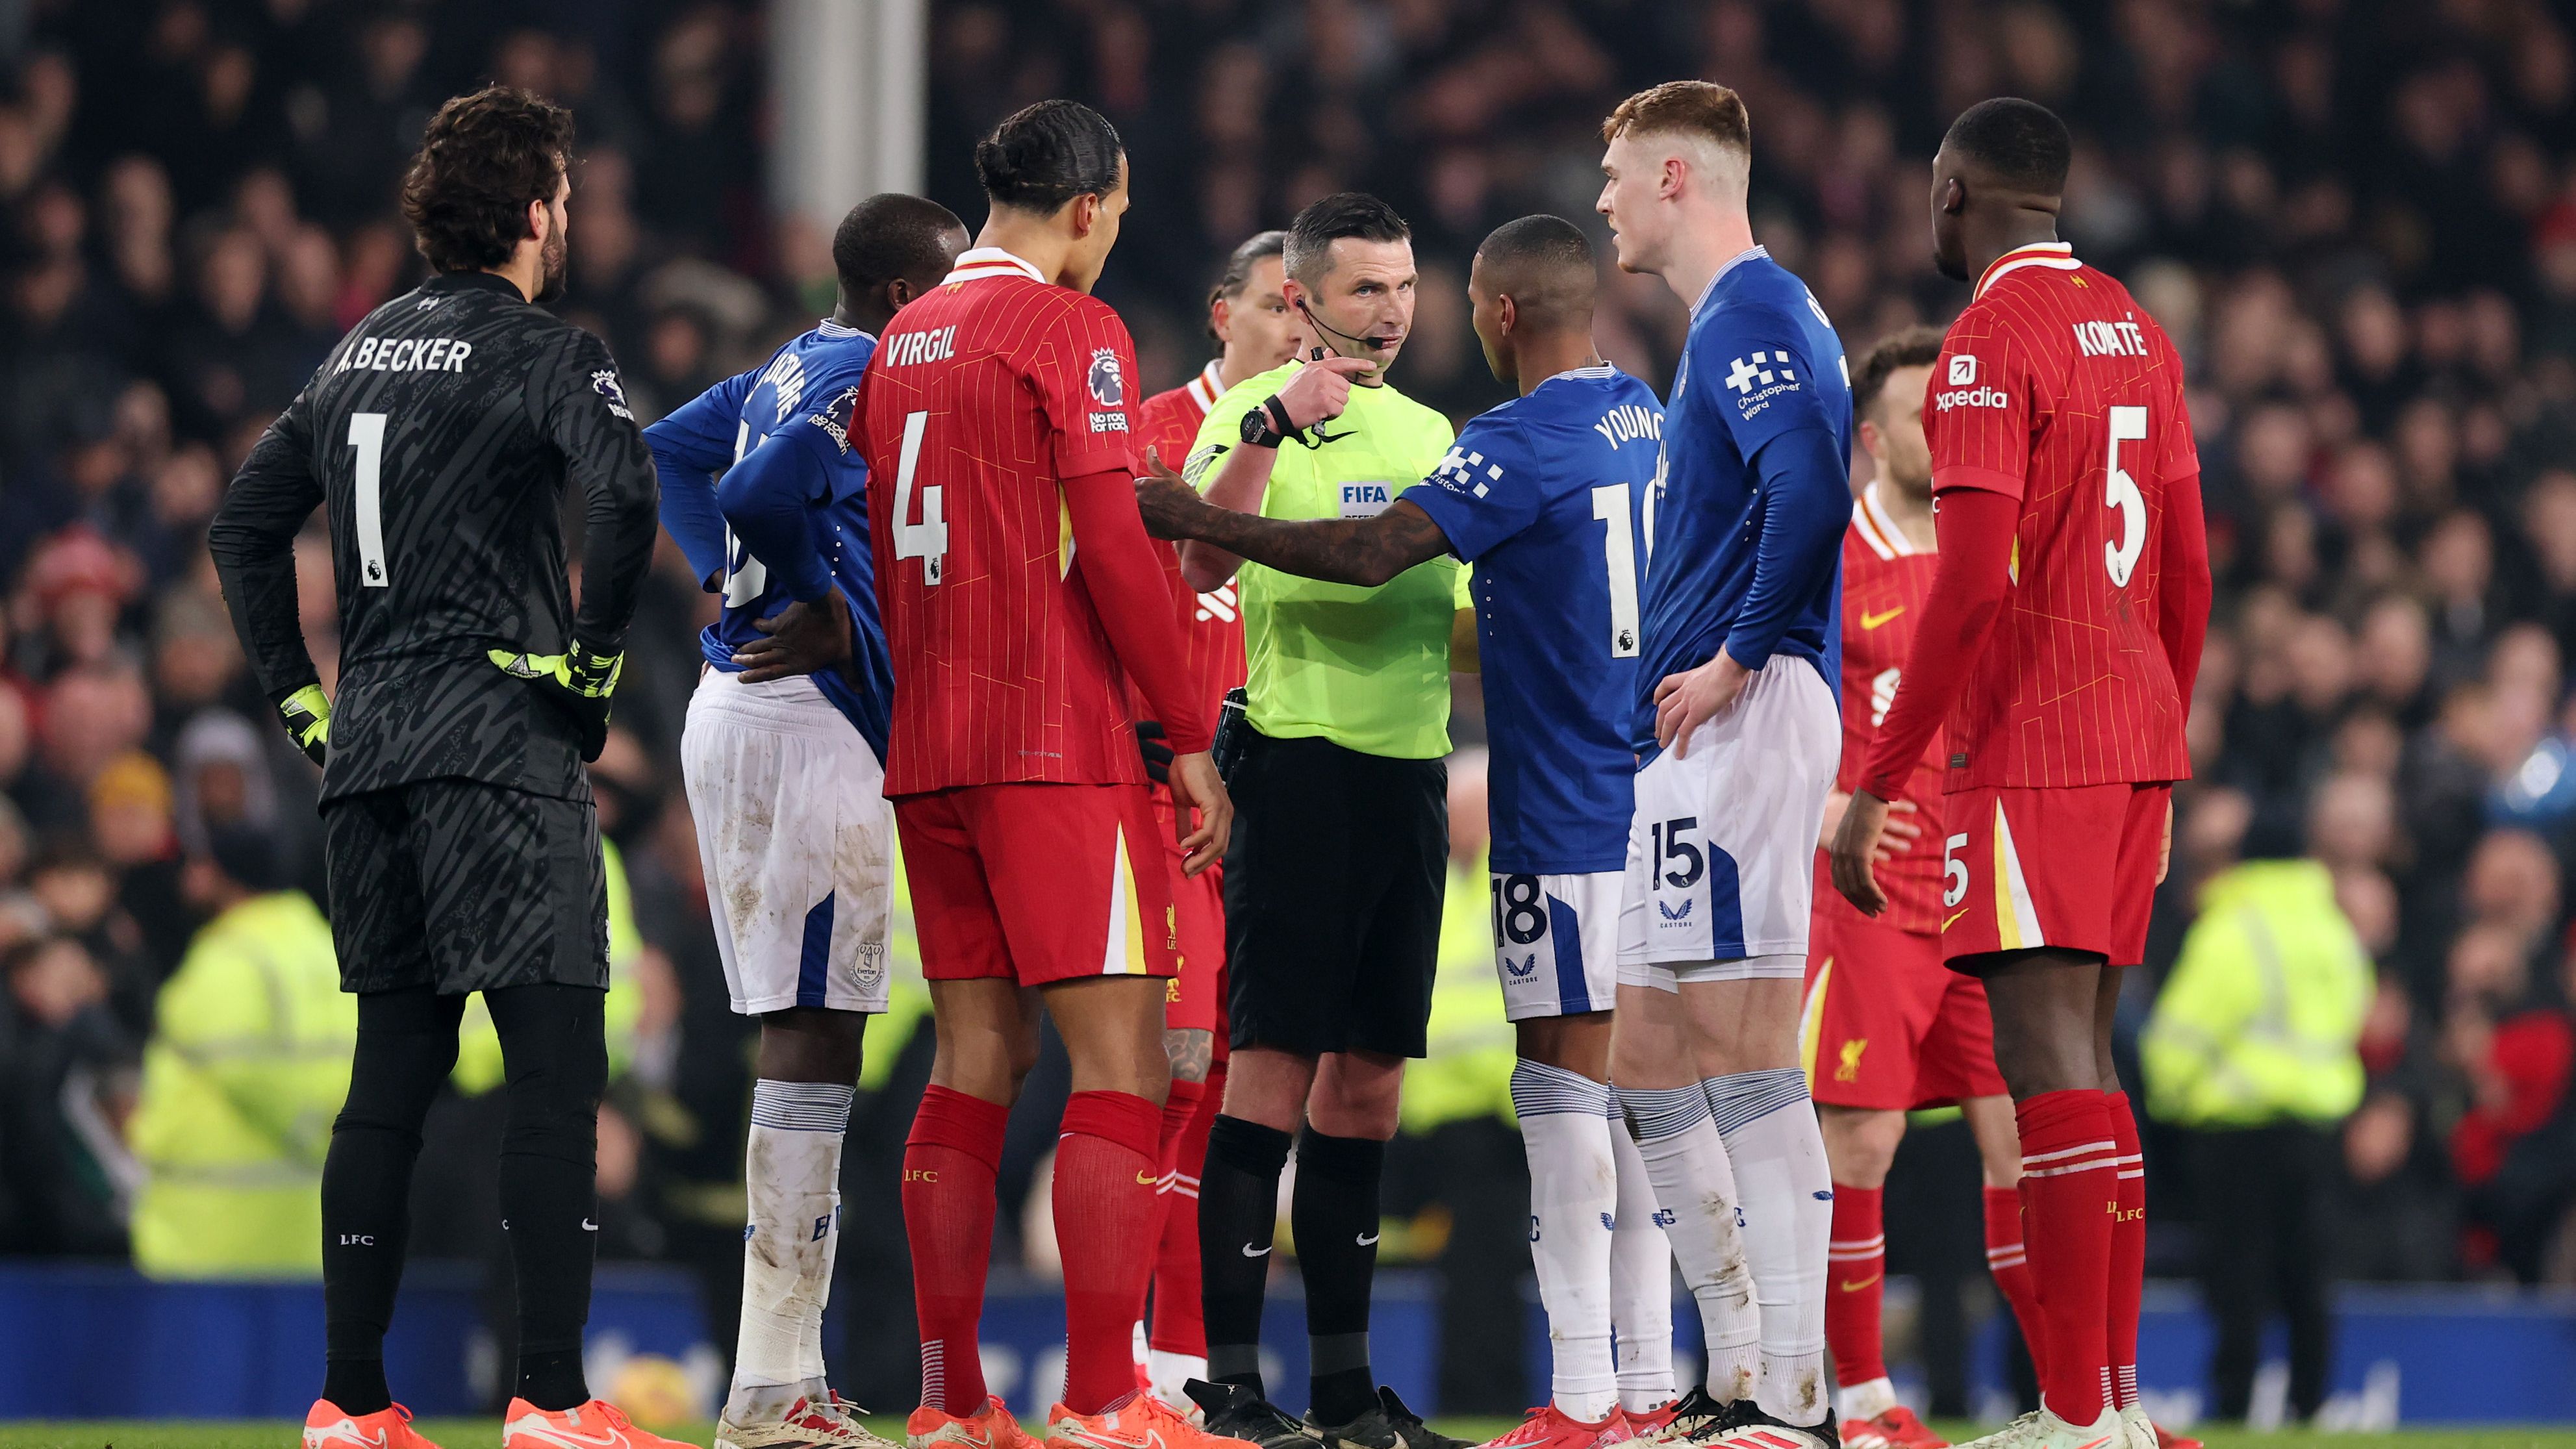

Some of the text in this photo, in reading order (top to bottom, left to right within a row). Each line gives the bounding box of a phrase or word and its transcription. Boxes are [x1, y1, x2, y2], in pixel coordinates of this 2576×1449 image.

[332, 336, 472, 375] A.BECKER
[886, 325, 956, 368] VIRGIL
[1737, 383, 1800, 410] Christopher
[1936, 386, 2008, 412] xpedia
[1089, 412, 1126, 423] No roo
[1742, 401, 1770, 421] Ward
[810, 414, 851, 447] No roo
[1091, 422, 1107, 433] for
[347, 412, 389, 587] 1
[892, 410, 948, 586] 4
[1343, 486, 1387, 503] FIFA
[2105, 405, 2147, 587] 5
[1591, 483, 1655, 658] 1
[1652, 816, 1704, 891] 15
[1943, 832, 1969, 907] 5
[1493, 874, 1547, 948] 18
[857, 967, 877, 976] Everton
[1509, 976, 1539, 986] CASTORE
[904, 1168, 939, 1183] LFC
[2115, 1207, 2144, 1222] LFC
[340, 1234, 375, 1246] LFC
